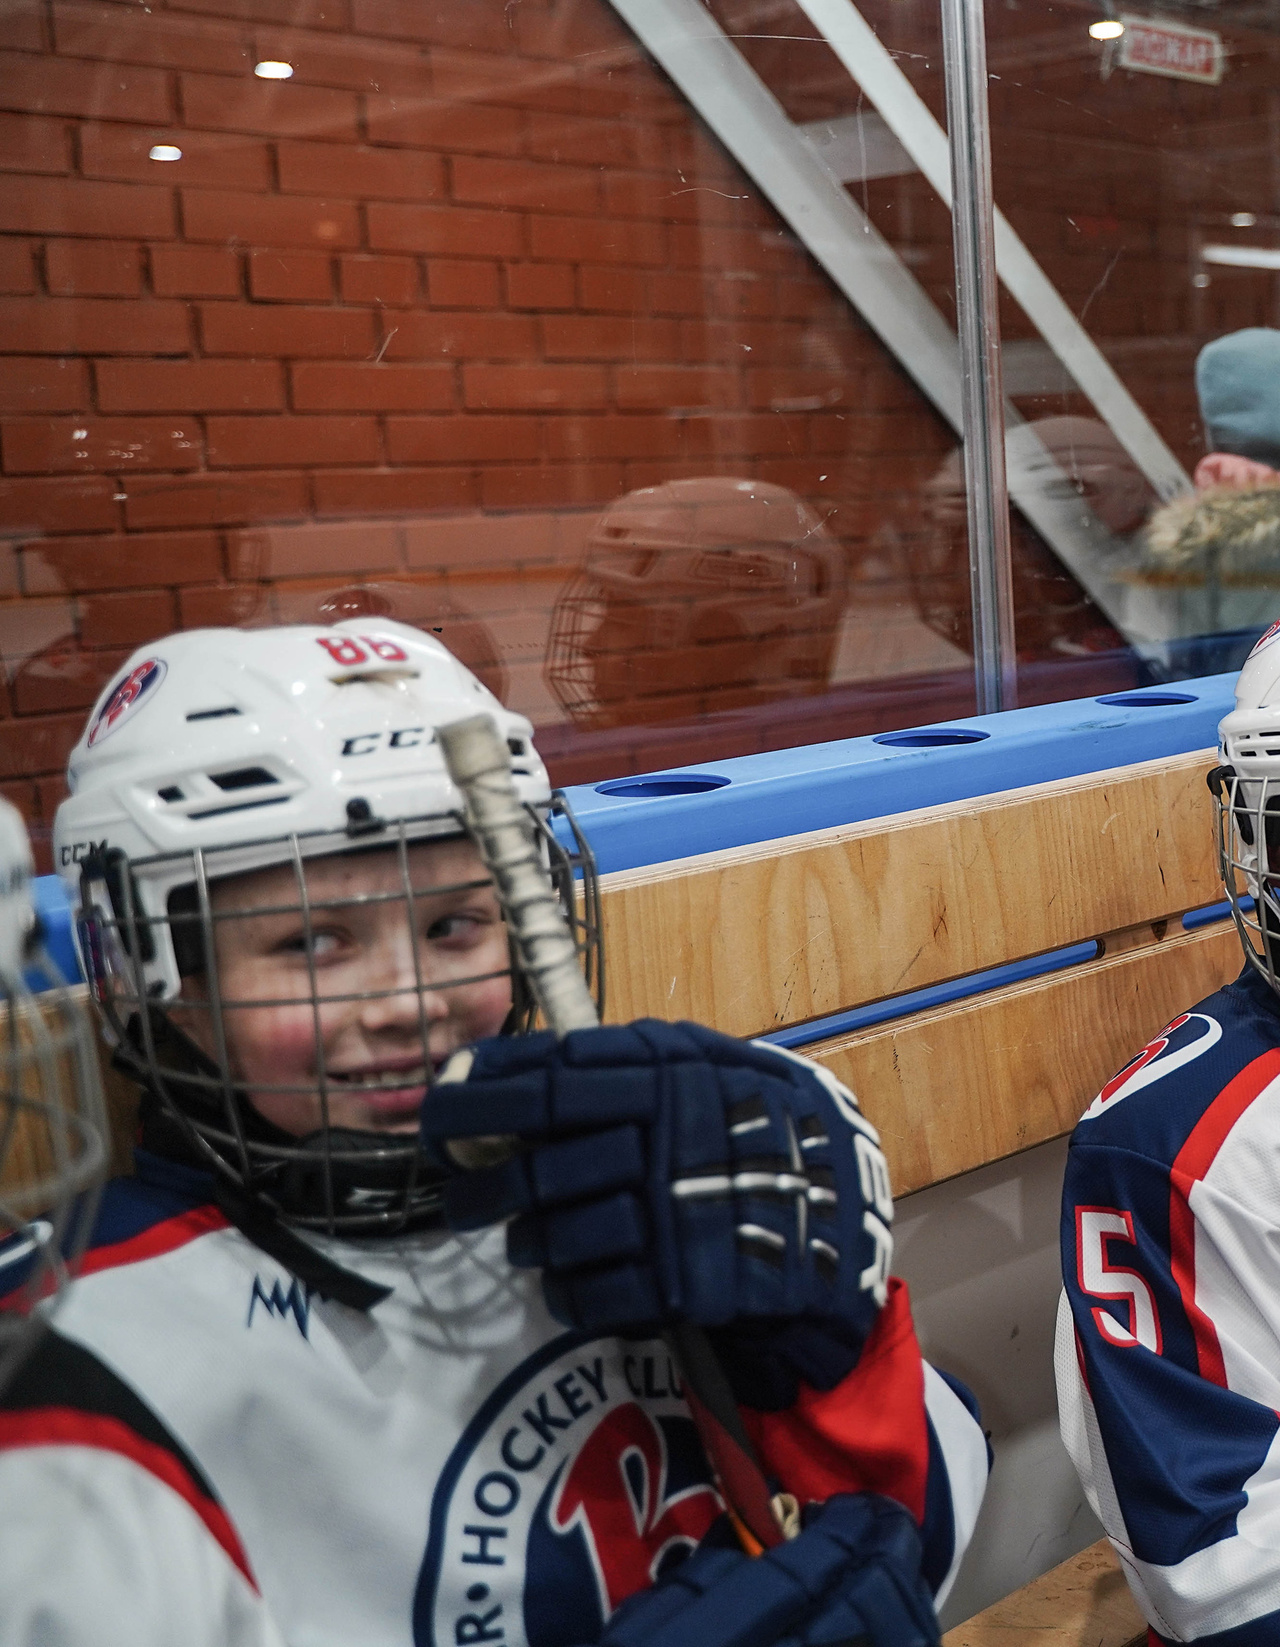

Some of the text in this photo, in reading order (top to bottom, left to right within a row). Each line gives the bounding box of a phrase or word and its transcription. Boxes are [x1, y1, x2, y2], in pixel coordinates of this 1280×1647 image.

[341, 726, 441, 757] CC
[1075, 1205, 1163, 1356] 5
[461, 1355, 686, 1566] HOCKEY CLU
